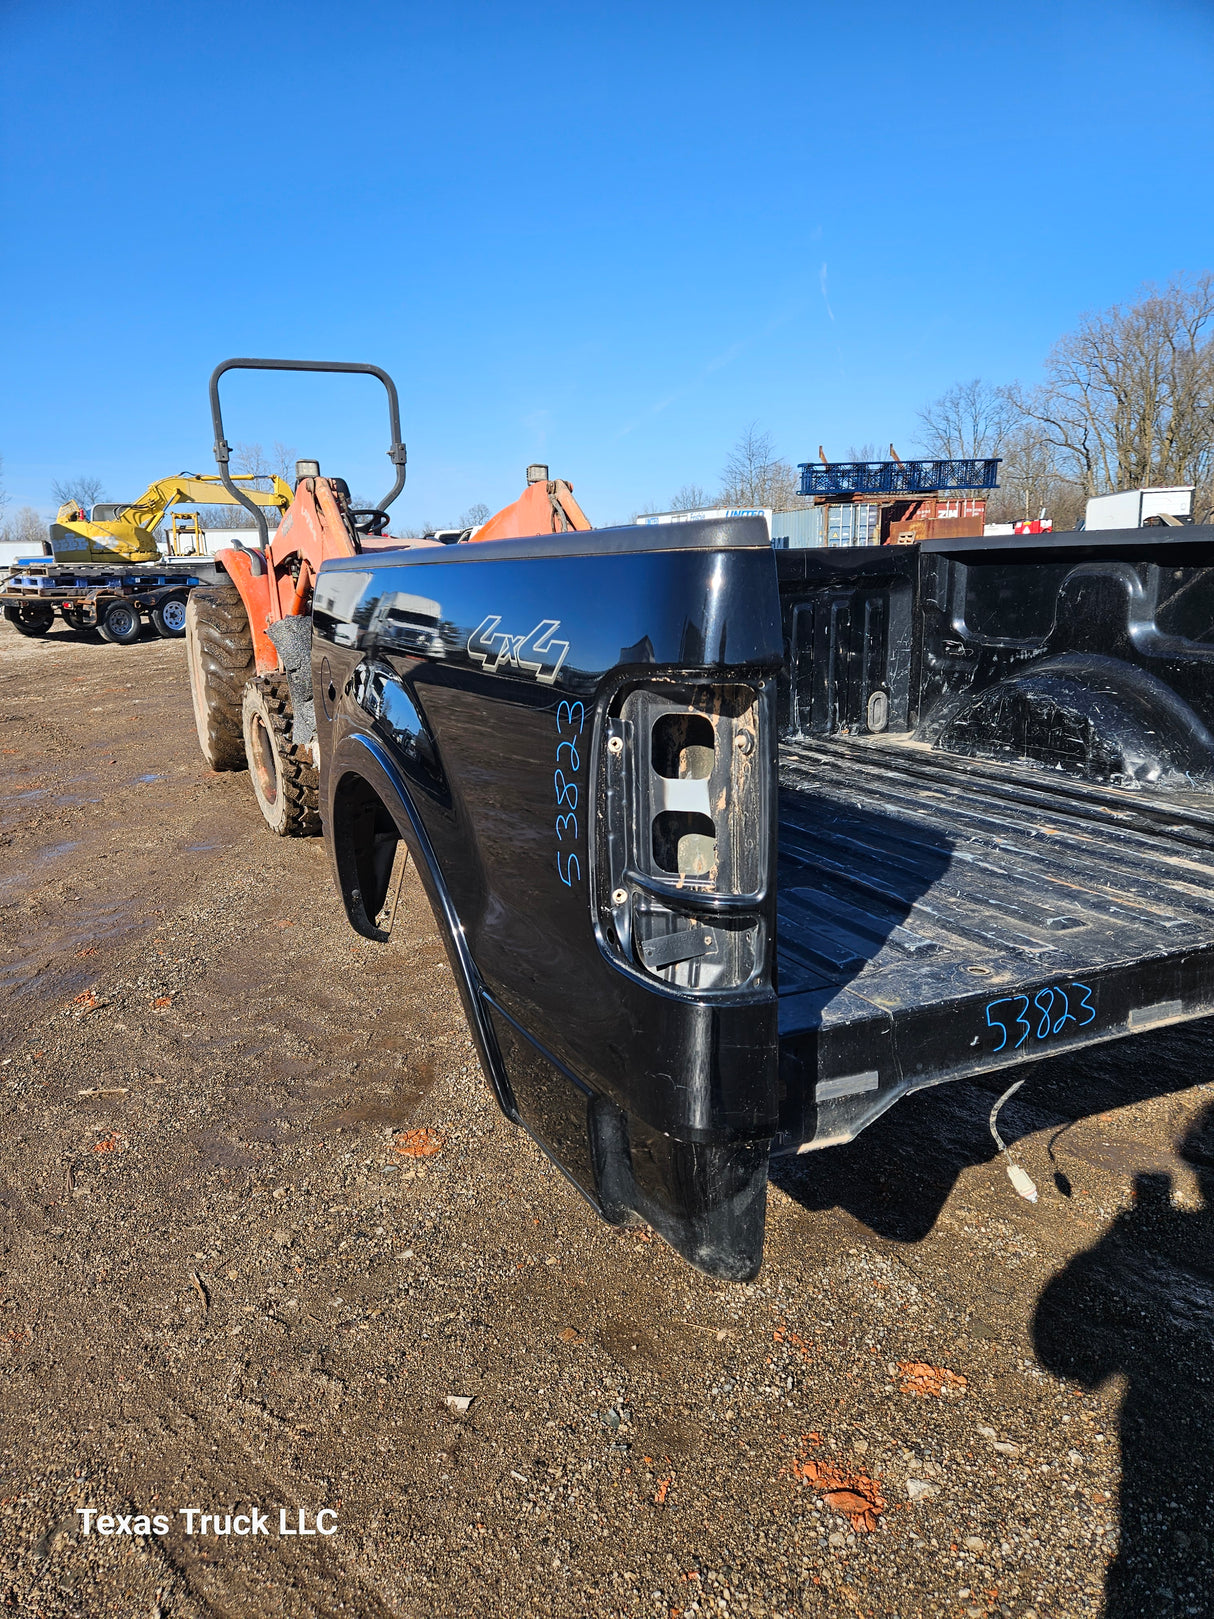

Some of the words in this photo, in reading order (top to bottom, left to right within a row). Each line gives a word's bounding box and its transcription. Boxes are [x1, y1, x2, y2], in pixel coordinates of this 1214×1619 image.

[467, 615, 570, 685] 4x4
[554, 700, 585, 887] 53823
[985, 982, 1097, 1052] 53823
